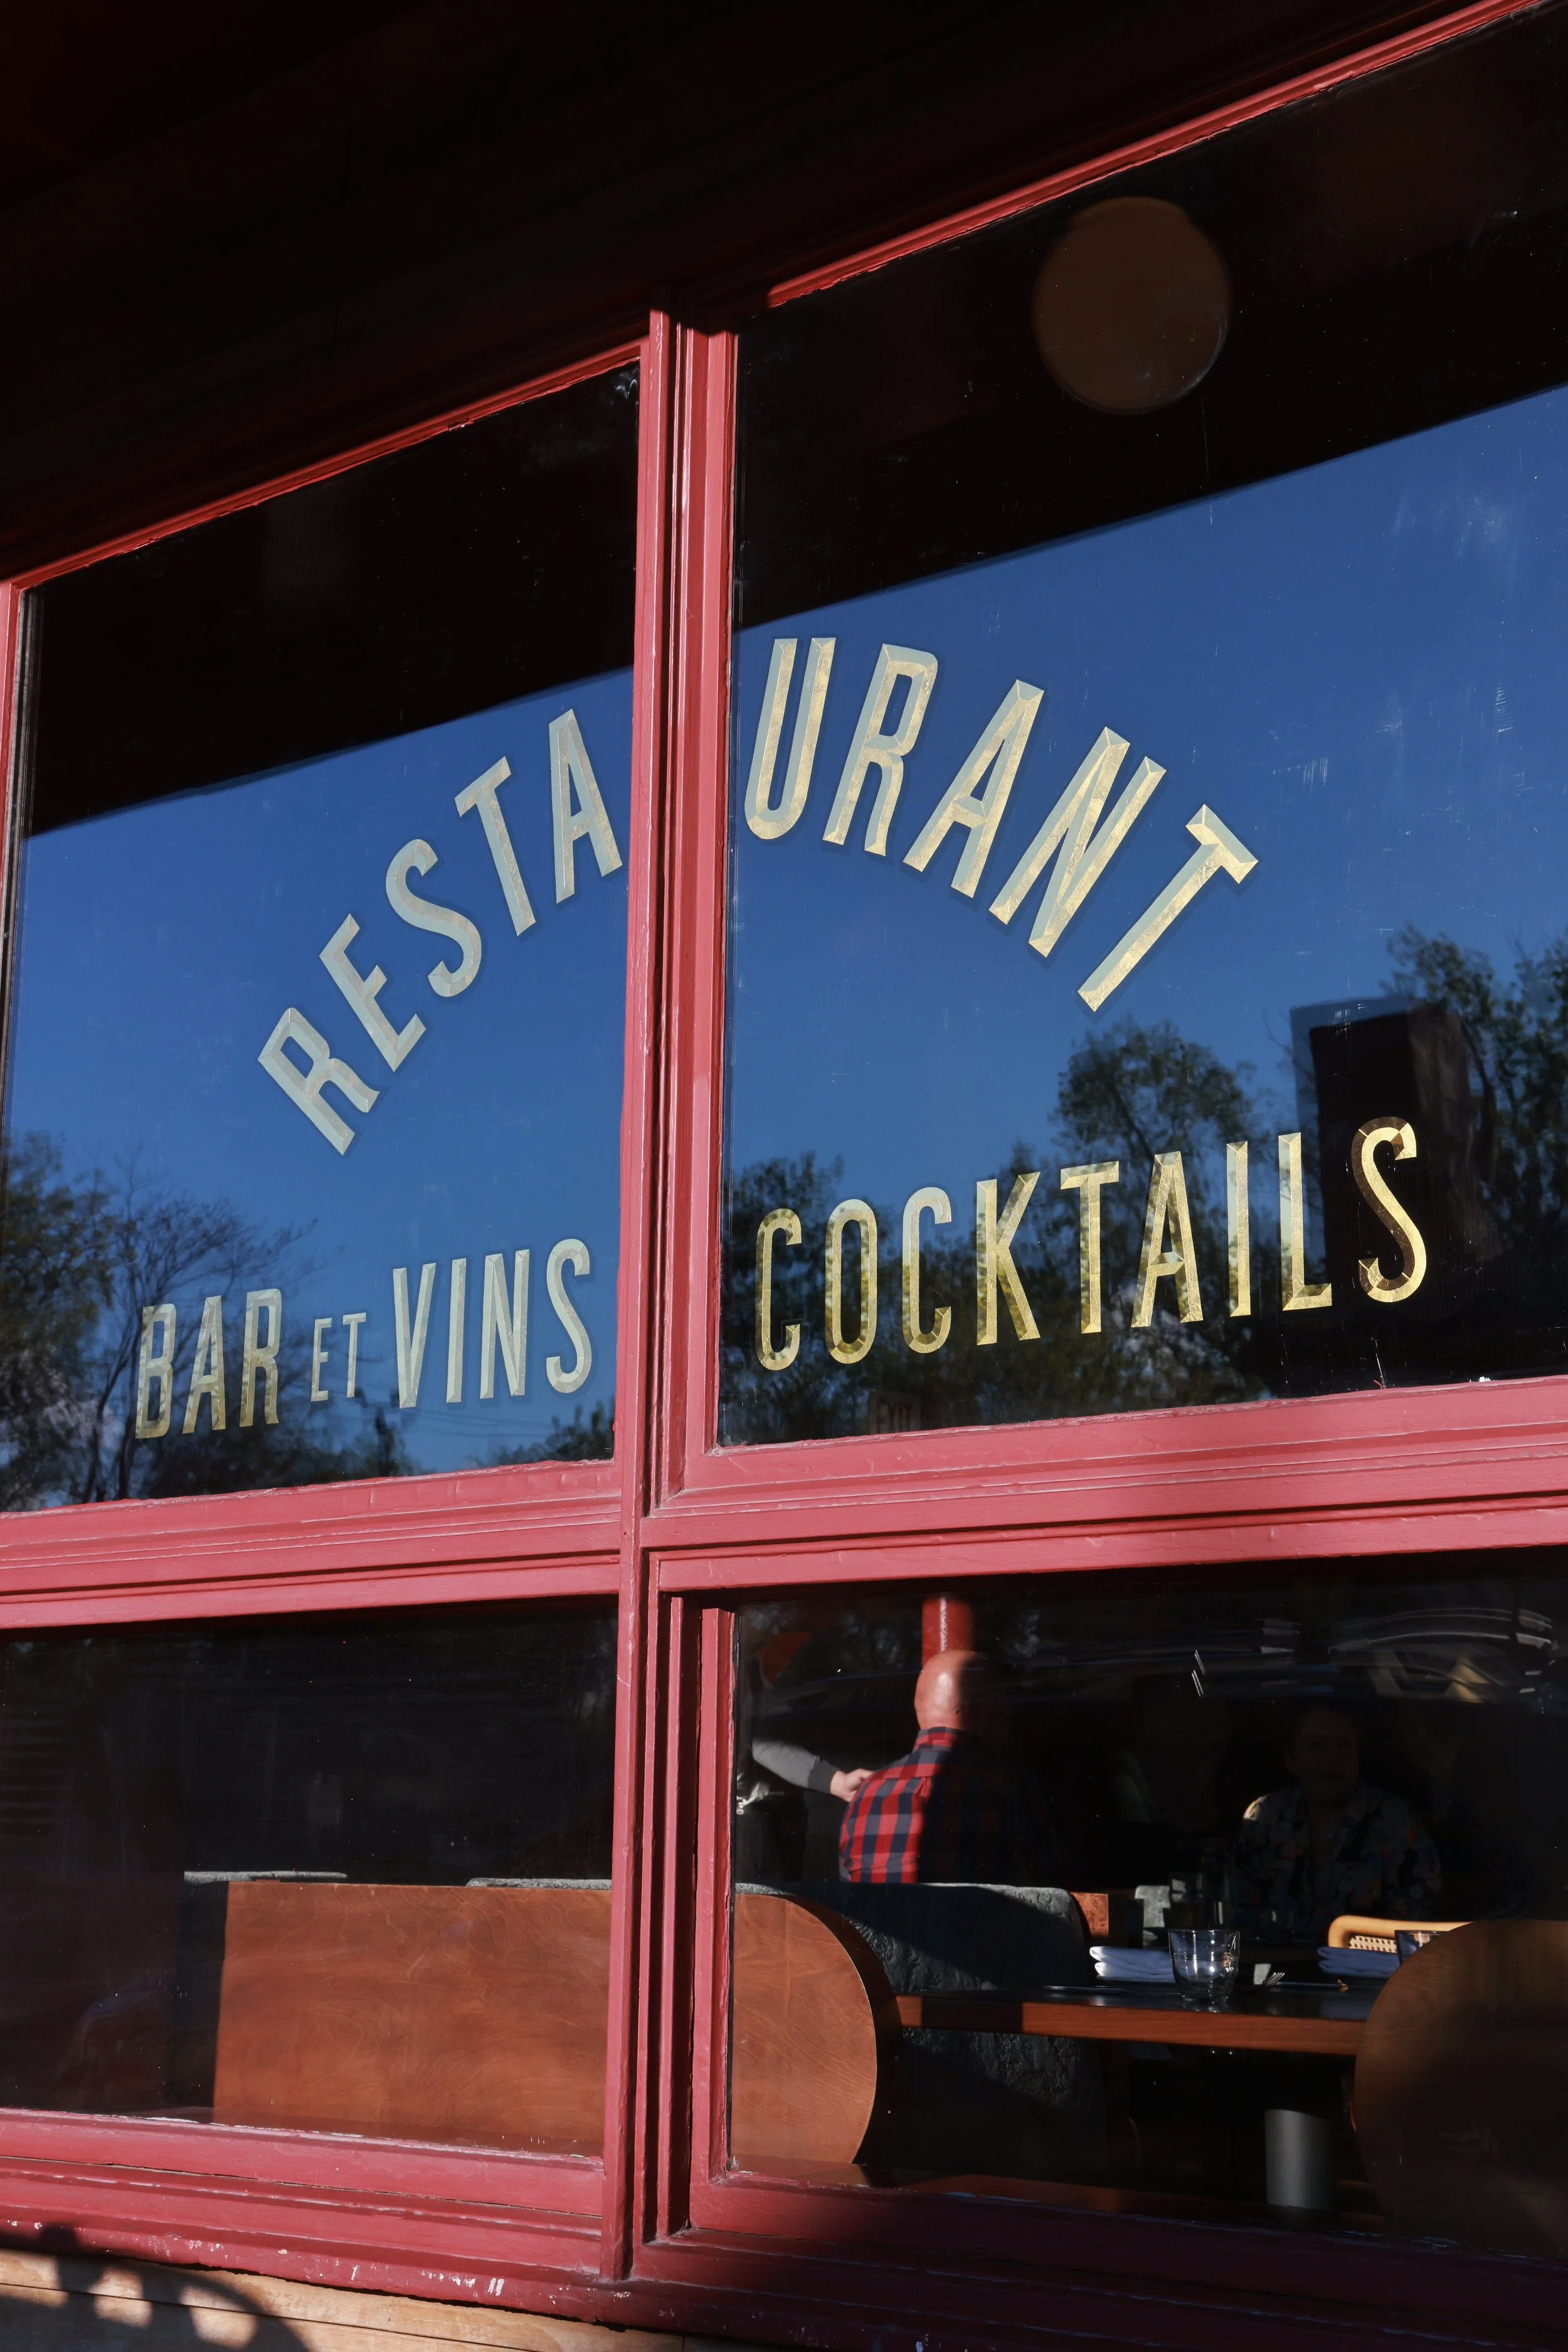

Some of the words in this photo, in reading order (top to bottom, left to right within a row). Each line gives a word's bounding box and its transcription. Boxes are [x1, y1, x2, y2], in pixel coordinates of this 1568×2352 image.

[257, 637, 1258, 1156] RESTAURANT
[135, 1289, 282, 1439] BAR
[310, 1311, 366, 1402] ET
[392, 1238, 591, 1409] VINS
[755, 1116, 1427, 1371] COCKTAILS
